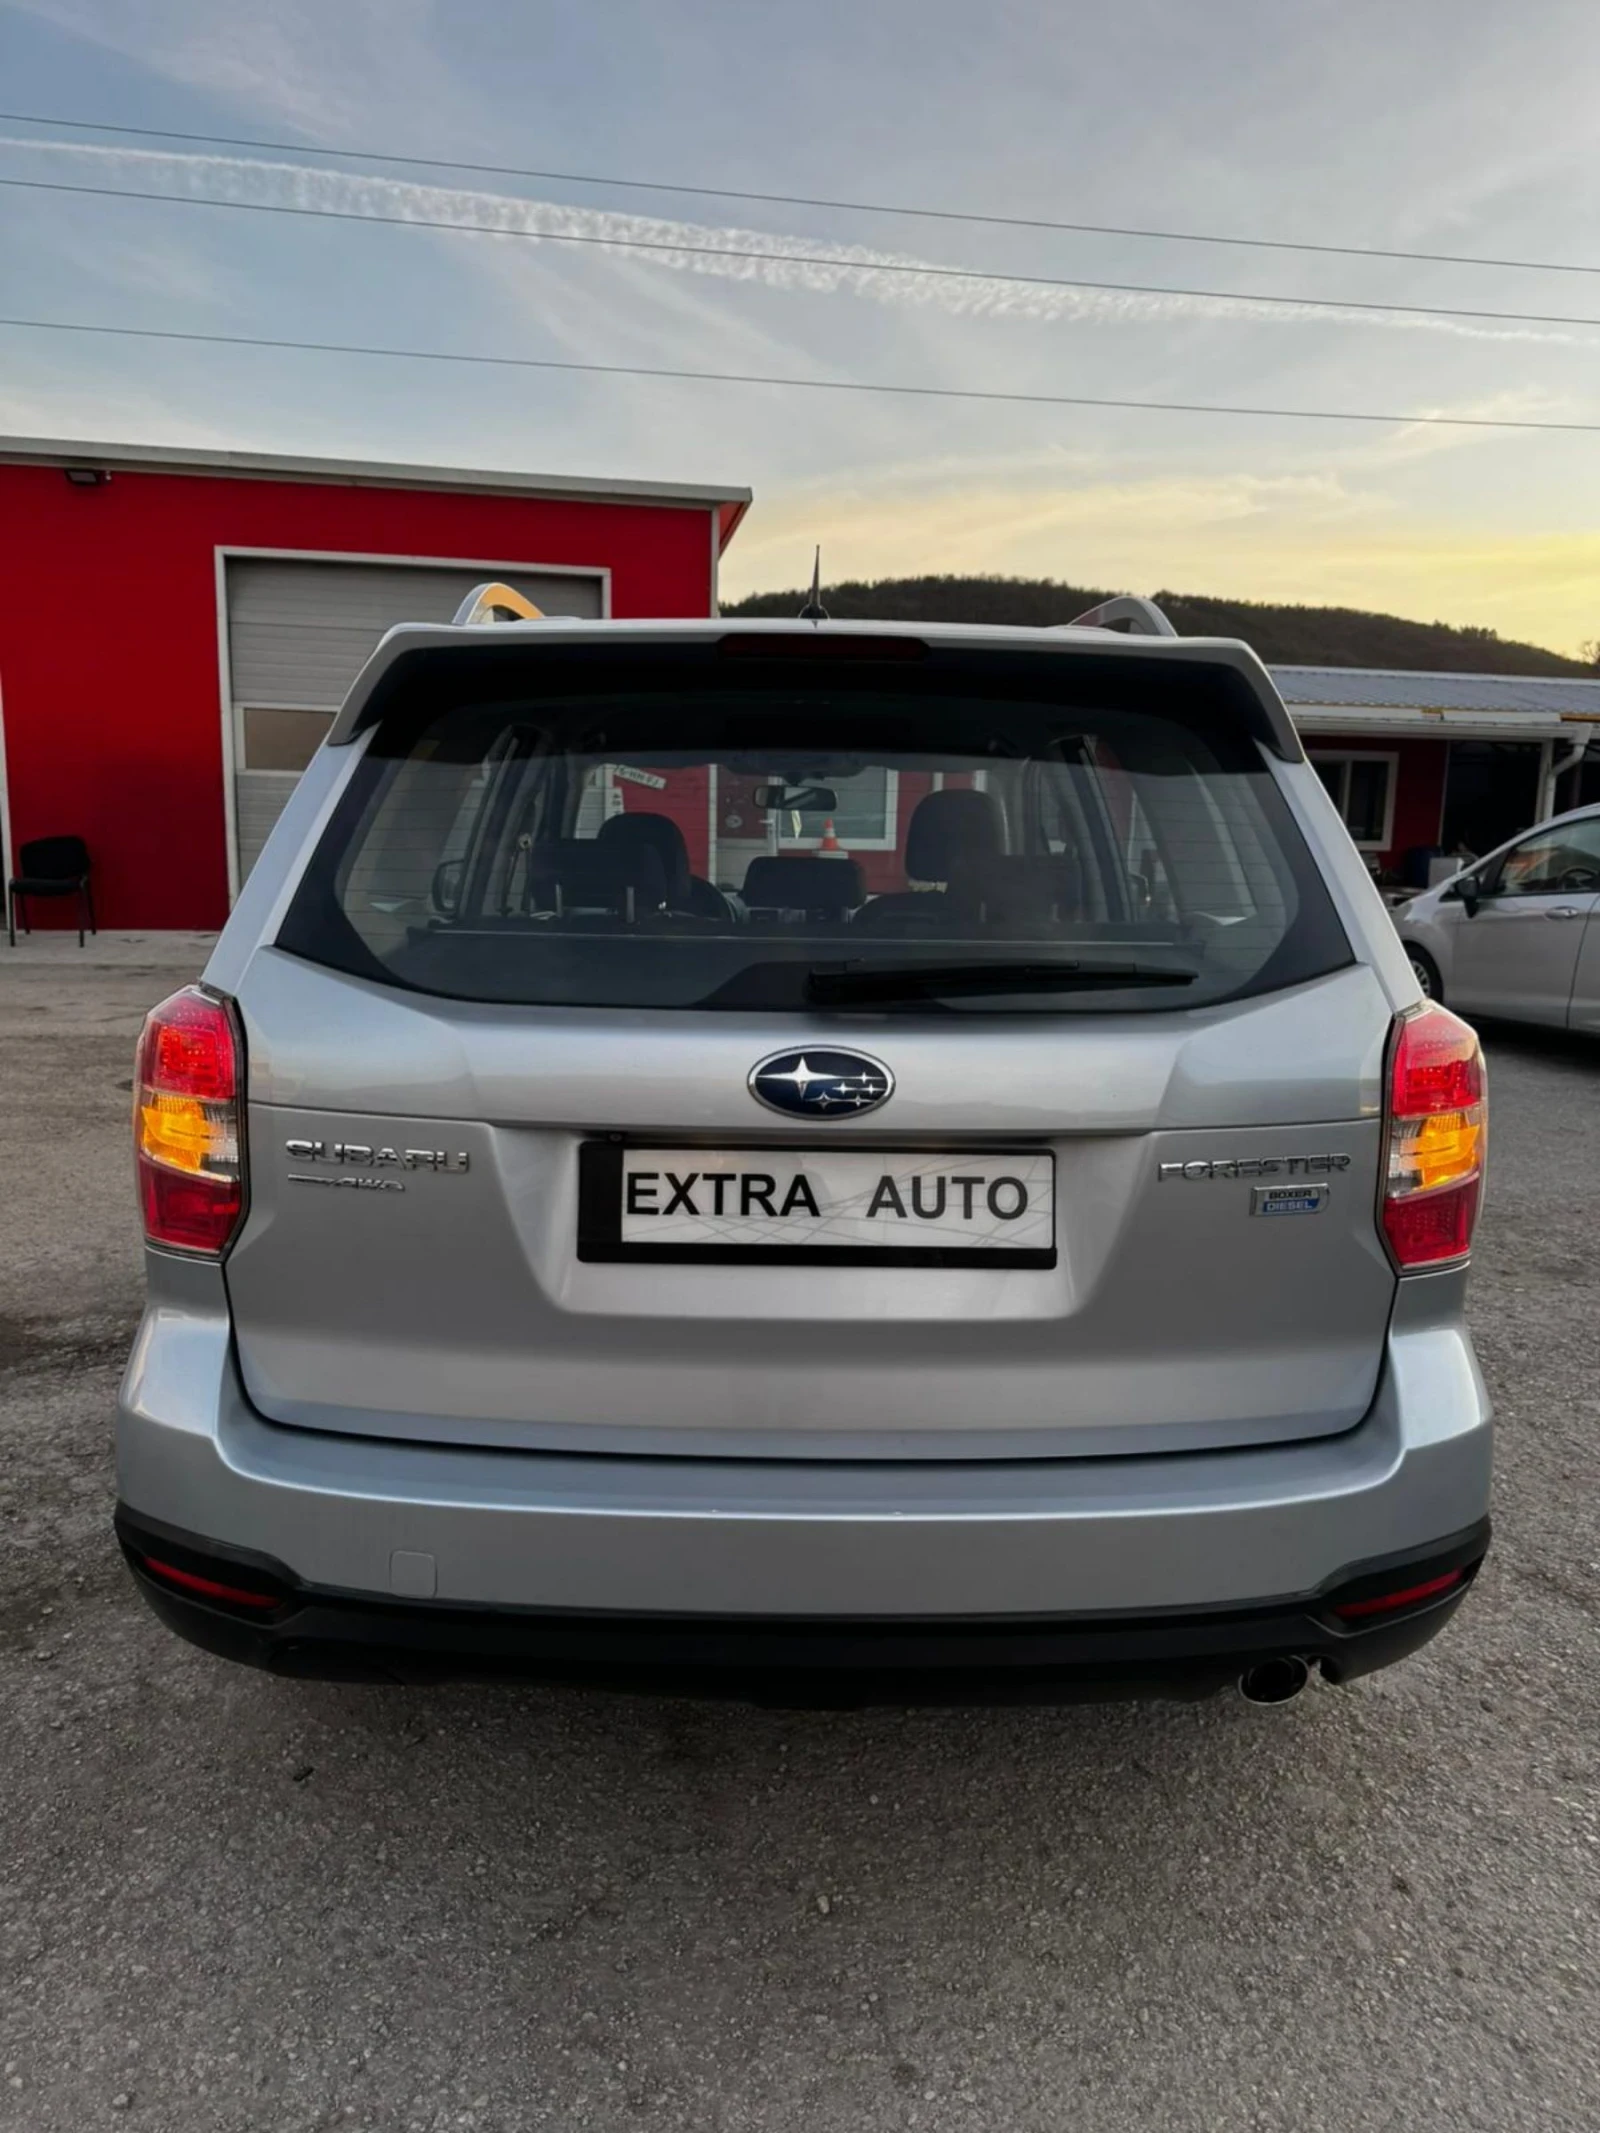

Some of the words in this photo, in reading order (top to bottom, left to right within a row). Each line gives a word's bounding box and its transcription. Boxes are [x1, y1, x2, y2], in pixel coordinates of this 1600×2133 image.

[286, 1139, 470, 1174] SUBARU
[1157, 1152, 1352, 1182] FORESTER
[626, 1171, 821, 1218] EXTRA
[865, 1175, 1029, 1221] AUTO
[1266, 1200, 1313, 1211] DIESEL
[1268, 1189, 1313, 1200] BOXER
